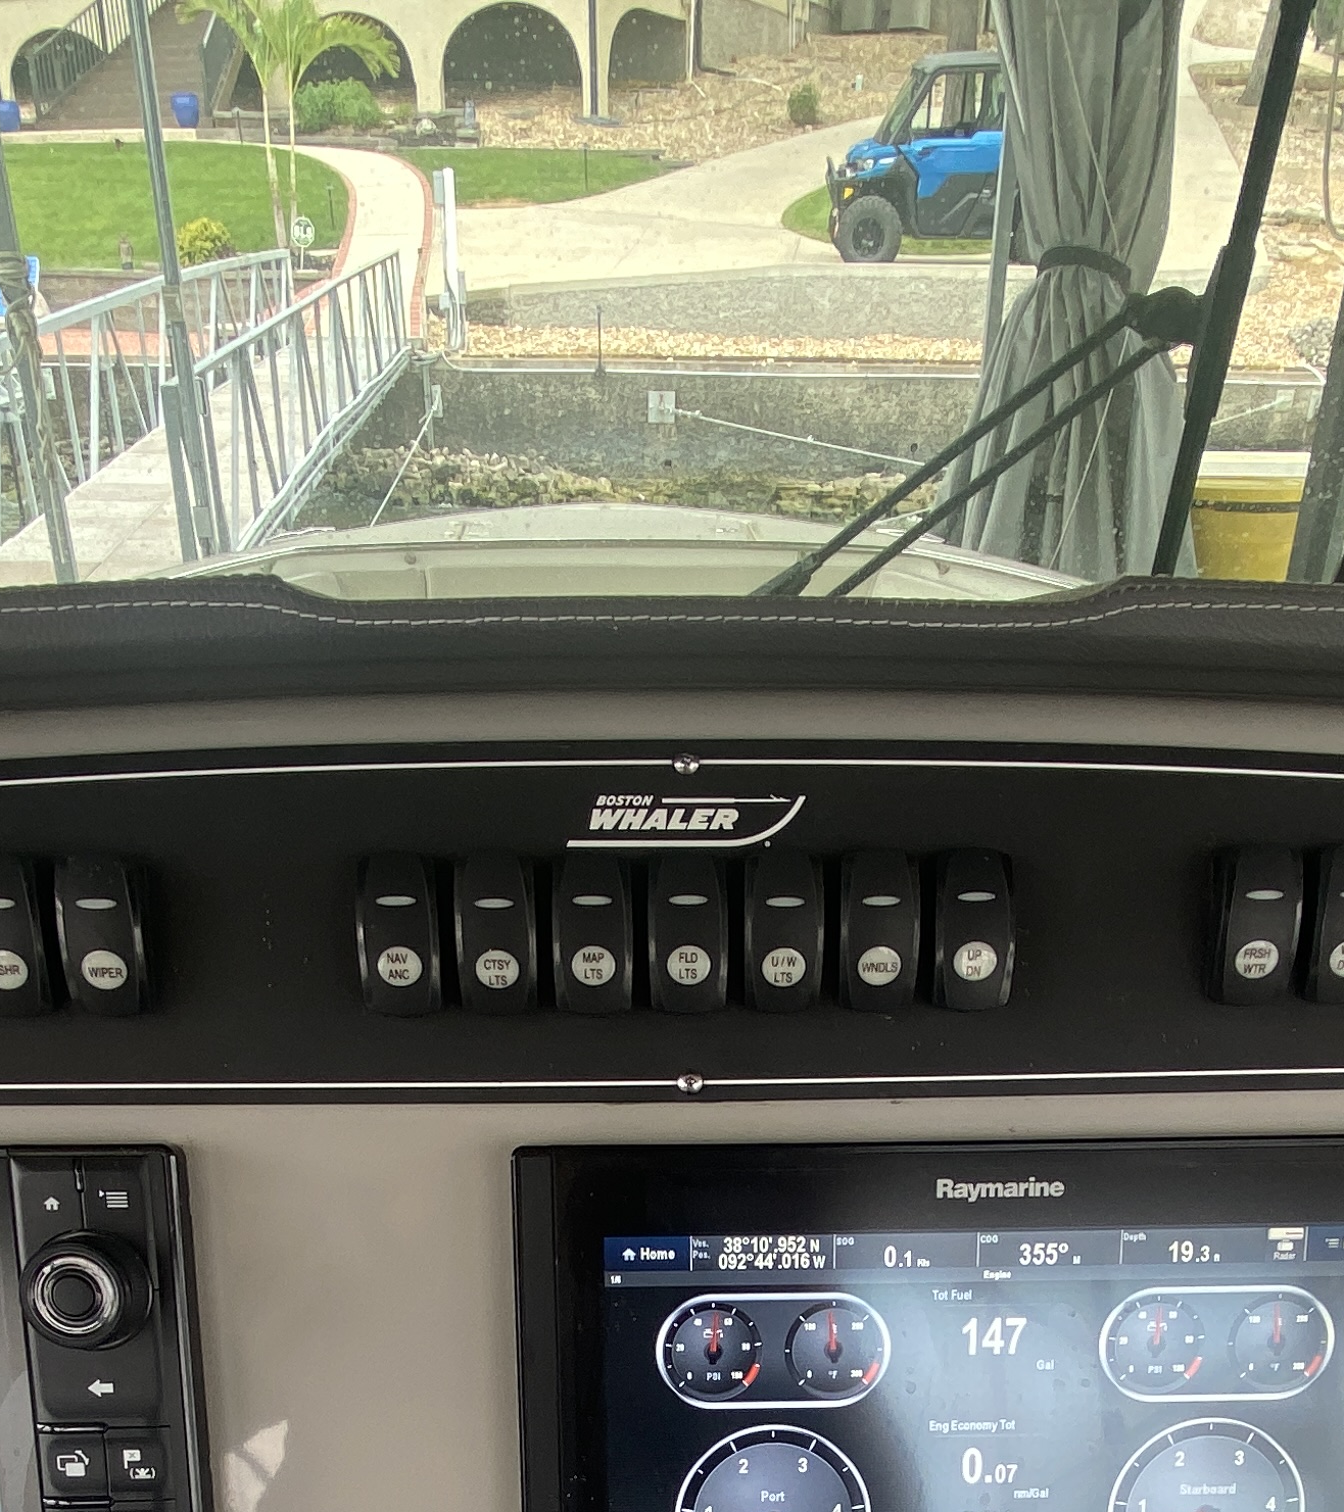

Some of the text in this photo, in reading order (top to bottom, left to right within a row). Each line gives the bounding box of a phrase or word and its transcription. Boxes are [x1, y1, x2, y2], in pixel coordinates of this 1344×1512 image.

[596, 794, 654, 807] BOSTON
[588, 807, 740, 831] WHALER
[386, 953, 408, 965] NAV
[581, 952, 605, 964] MAP
[678, 952, 699, 964] FLD
[967, 949, 983, 961] UP
[1243, 948, 1271, 960] FRSH
[483, 959, 511, 971] CTSY
[861, 962, 899, 974] WNDLS
[965, 965, 982, 977] DN
[1242, 963, 1267, 975] WTR
[87, 966, 125, 979] WIPER
[387, 969, 410, 981] ANC
[583, 968, 604, 980] LTS
[678, 968, 698, 980] LTS
[773, 972, 794, 983] LTS
[488, 974, 508, 986] LTS
[935, 1177, 1066, 1203] Raymarine
[1123, 1231, 1147, 1243] Depth
[809, 1239, 820, 1253] N
[1168, 1240, 1211, 1263] 19.3
[639, 1247, 676, 1261] Home
[883, 1245, 913, 1268] 0.1
[1018, 1242, 1069, 1266] 355°
[813, 1254, 826, 1268] W
[932, 1288, 973, 1301] Tot Fuel
[960, 1316, 1028, 1357] 147
[1036, 1358, 1055, 1372] Gal
[928, 1418, 1016, 1434] Eng Economy Tot
[1174, 1450, 1186, 1467] 2
[1234, 1449, 1245, 1467] 3
[738, 1458, 749, 1474] 2
[797, 1457, 808, 1473] 3
[960, 1446, 1019, 1486] 0.07
[1179, 1481, 1237, 1496] Starboard
[760, 1490, 785, 1503] Port
[1265, 1496, 1277, 1512] 4
